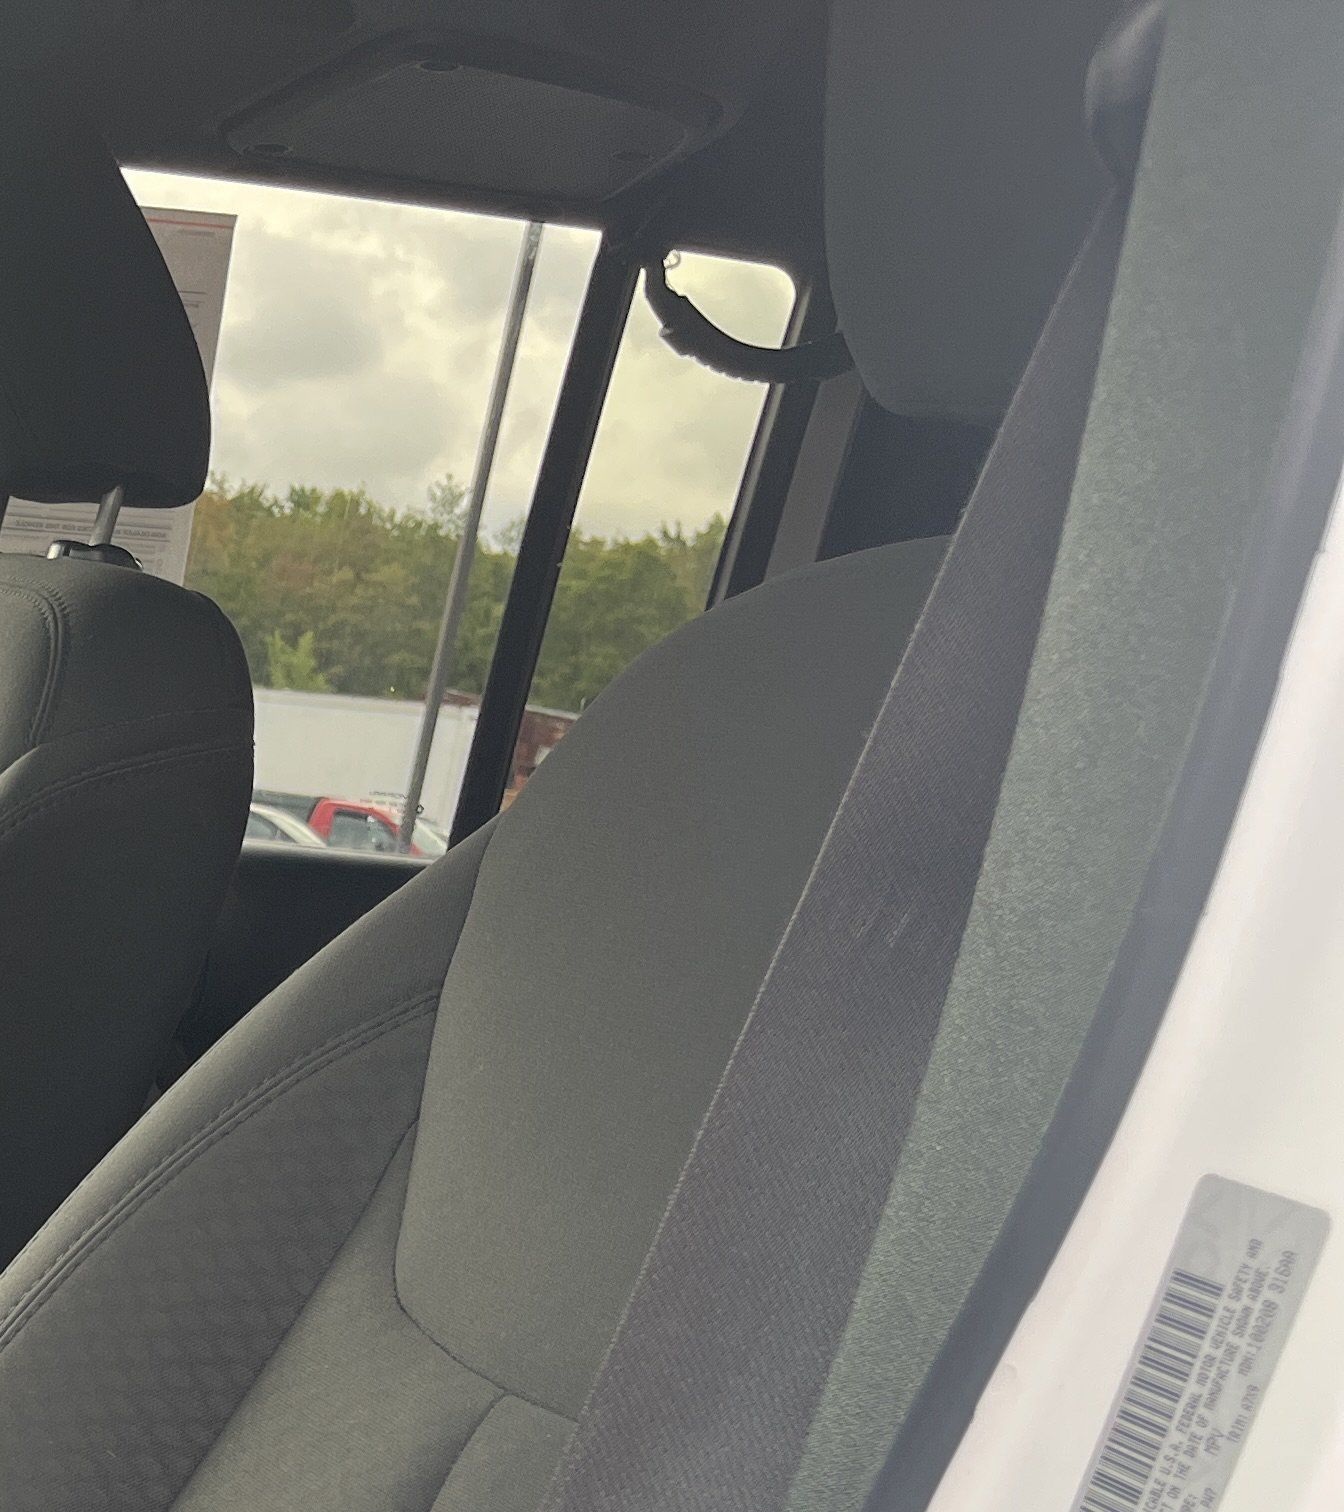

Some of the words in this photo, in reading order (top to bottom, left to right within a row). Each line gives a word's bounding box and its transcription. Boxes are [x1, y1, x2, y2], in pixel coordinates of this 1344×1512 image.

[1173, 1387, 1203, 1435] FEDERAL
[1192, 1351, 1217, 1387] MOTOR
[1206, 1304, 1237, 1351] VEHICLE
[1225, 1261, 1254, 1302] SAFETY
[1243, 1236, 1264, 1260] AND
[1229, 1303, 1256, 1339] SHOWN
[1200, 1339, 1241, 1412] MANUFACTURE
[1193, 1411, 1212, 1429] OF
[1181, 1429, 1204, 1459] DATE
[1201, 1425, 1227, 1456] MPV
[1172, 1460, 1192, 1482] THE
[1164, 1482, 1183, 1501] ON
